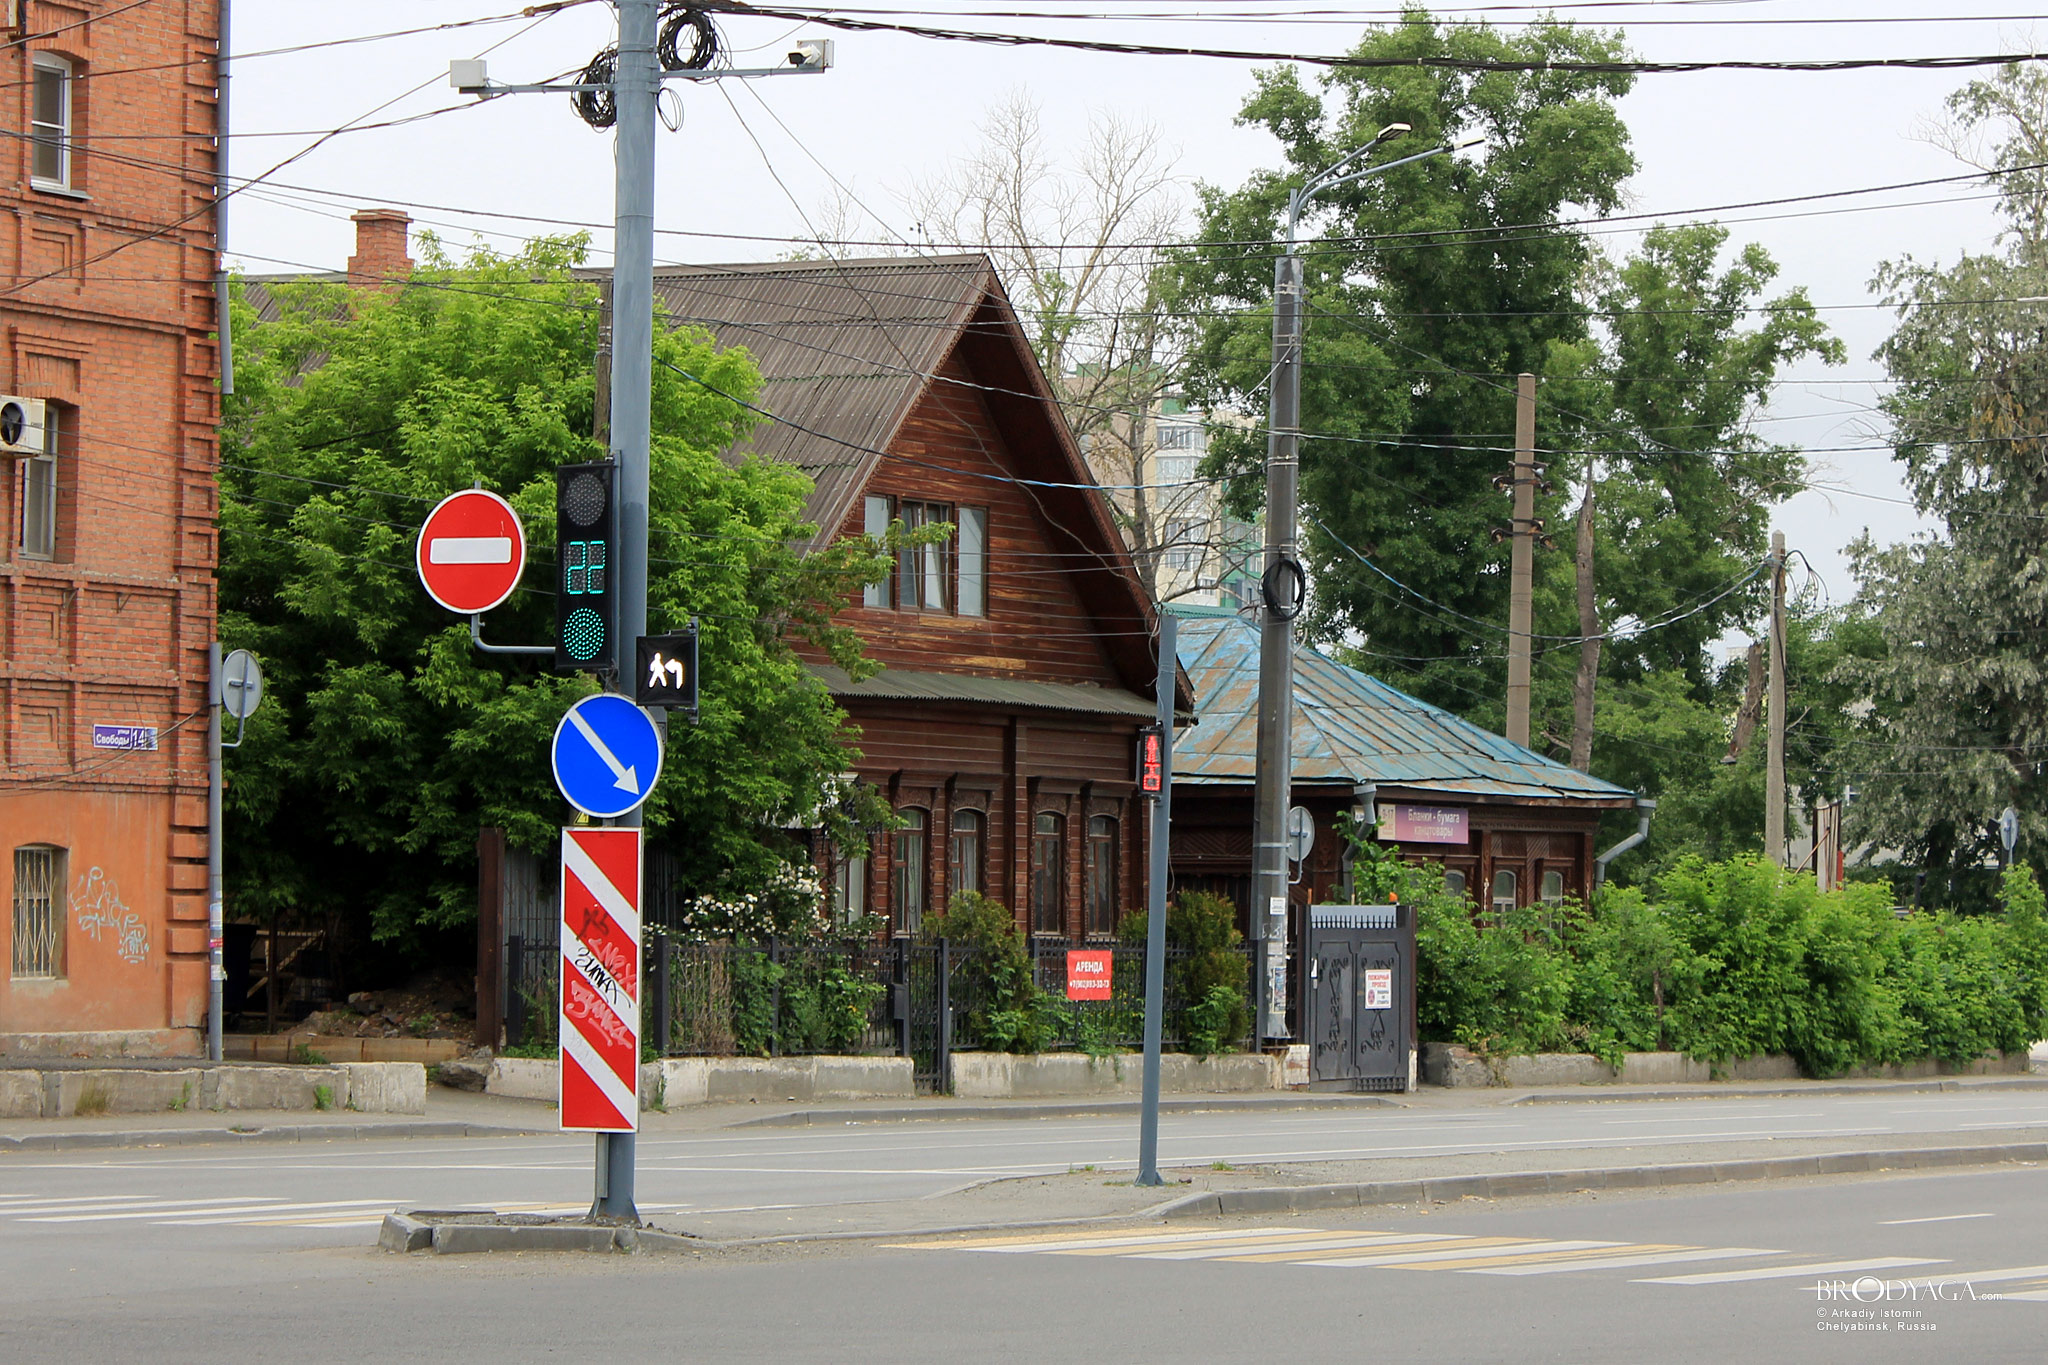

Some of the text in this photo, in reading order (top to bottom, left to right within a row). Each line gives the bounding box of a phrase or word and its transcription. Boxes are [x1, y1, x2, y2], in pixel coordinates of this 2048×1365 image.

[567, 540, 606, 595] 22
[96, 733, 130, 746] Свободы
[1408, 808, 1460, 825] Бланки бумага
[1414, 826, 1453, 839] канцтовары
[1075, 961, 1104, 974] АРЕНДА
